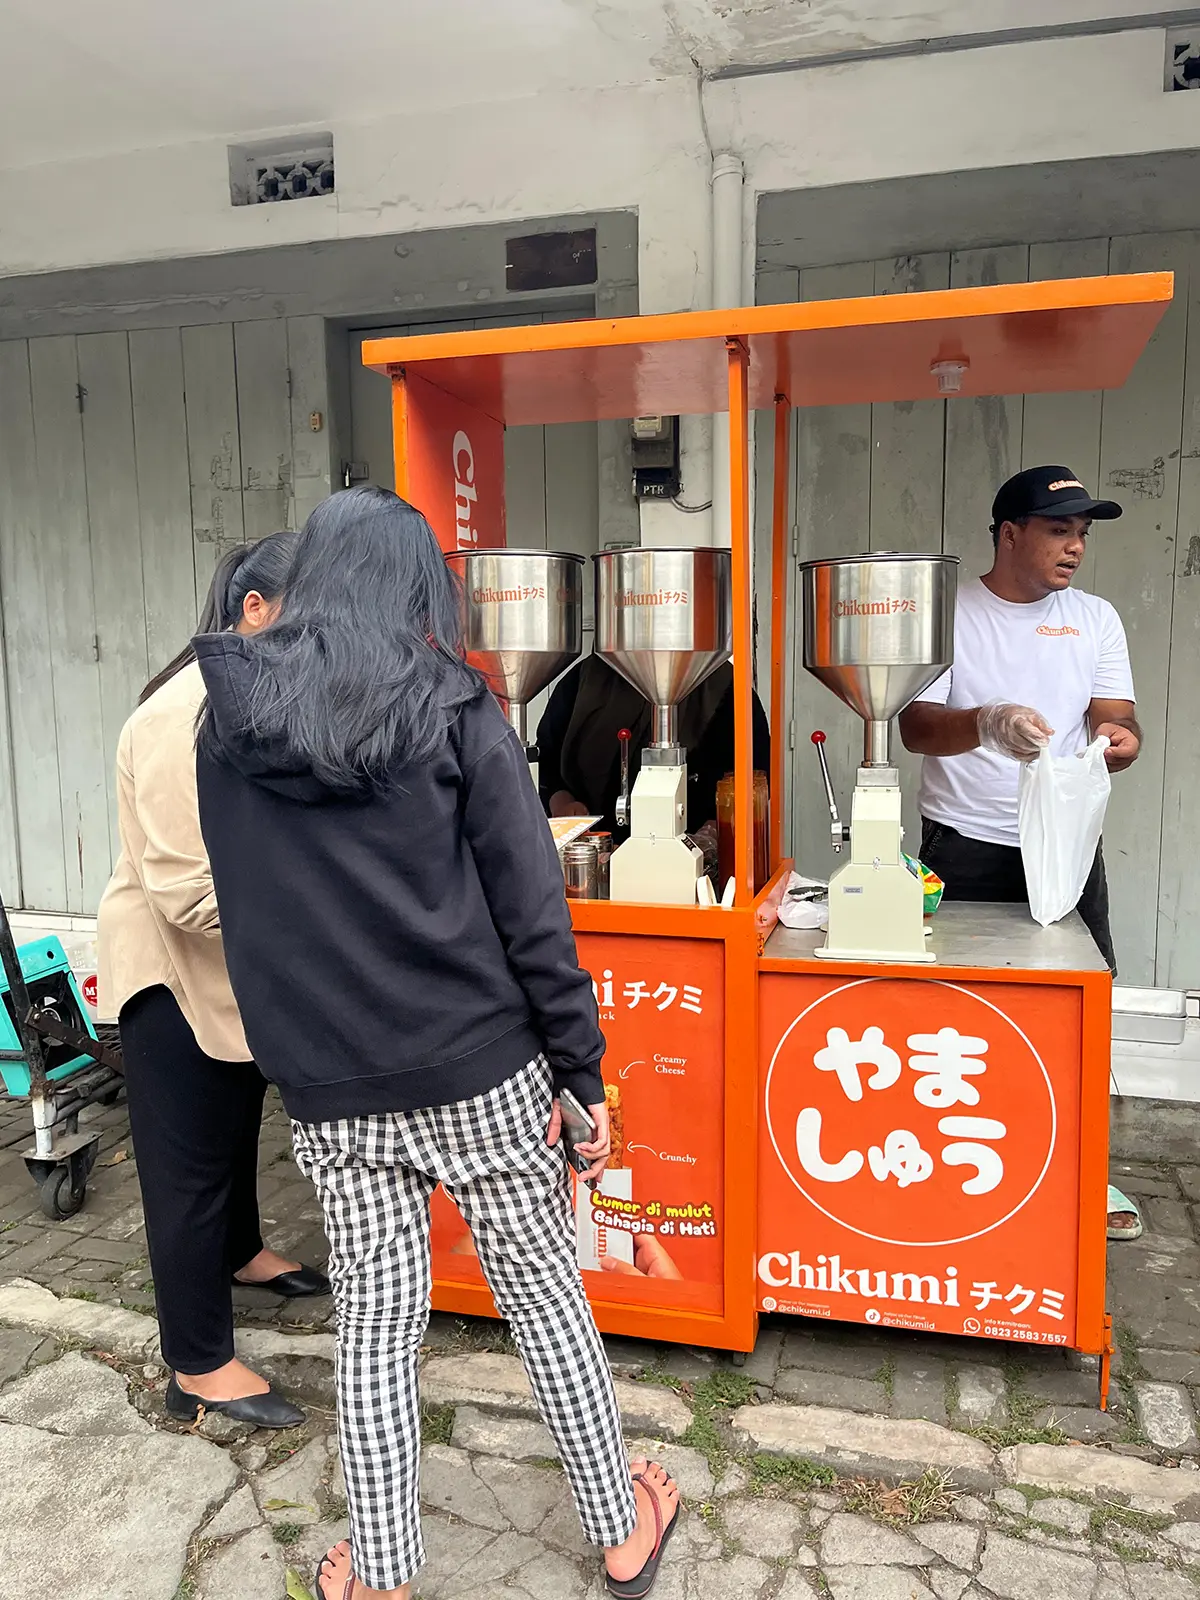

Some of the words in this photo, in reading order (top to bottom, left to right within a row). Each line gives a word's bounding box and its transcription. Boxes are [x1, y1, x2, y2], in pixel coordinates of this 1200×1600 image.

[452, 430, 478, 550] Chi
[643, 485, 664, 495] PTR
[473, 585, 523, 604] Chikumi
[523, 586, 545, 600] チクミ
[664, 591, 688, 605] チクミ
[834, 597, 890, 618] Chikumi
[891, 599, 917, 613] チクミ
[623, 981, 702, 1014] チクミ
[653, 1053, 687, 1066] Creamy
[813, 1025, 989, 1108] やま
[655, 1064, 686, 1076] Cheese
[659, 1151, 697, 1165] Crunchy
[796, 1107, 1007, 1196] しゅう
[592, 1191, 641, 1213] Lumer
[646, 1202, 661, 1216] di
[666, 1203, 712, 1218] mulut
[593, 1209, 655, 1233] Bahagia
[659, 1220, 674, 1235] di
[679, 1220, 716, 1235] Hati
[757, 1250, 960, 1308] Chikumi
[970, 1280, 1066, 1321] チクミ
[778, 1304, 831, 1317] @chikumi.id
[984, 1317, 997, 1325] Info
[984, 1326, 1011, 1338] 0823
[1013, 1329, 1039, 1341] 2583
[1041, 1332, 1067, 1344] 7557
